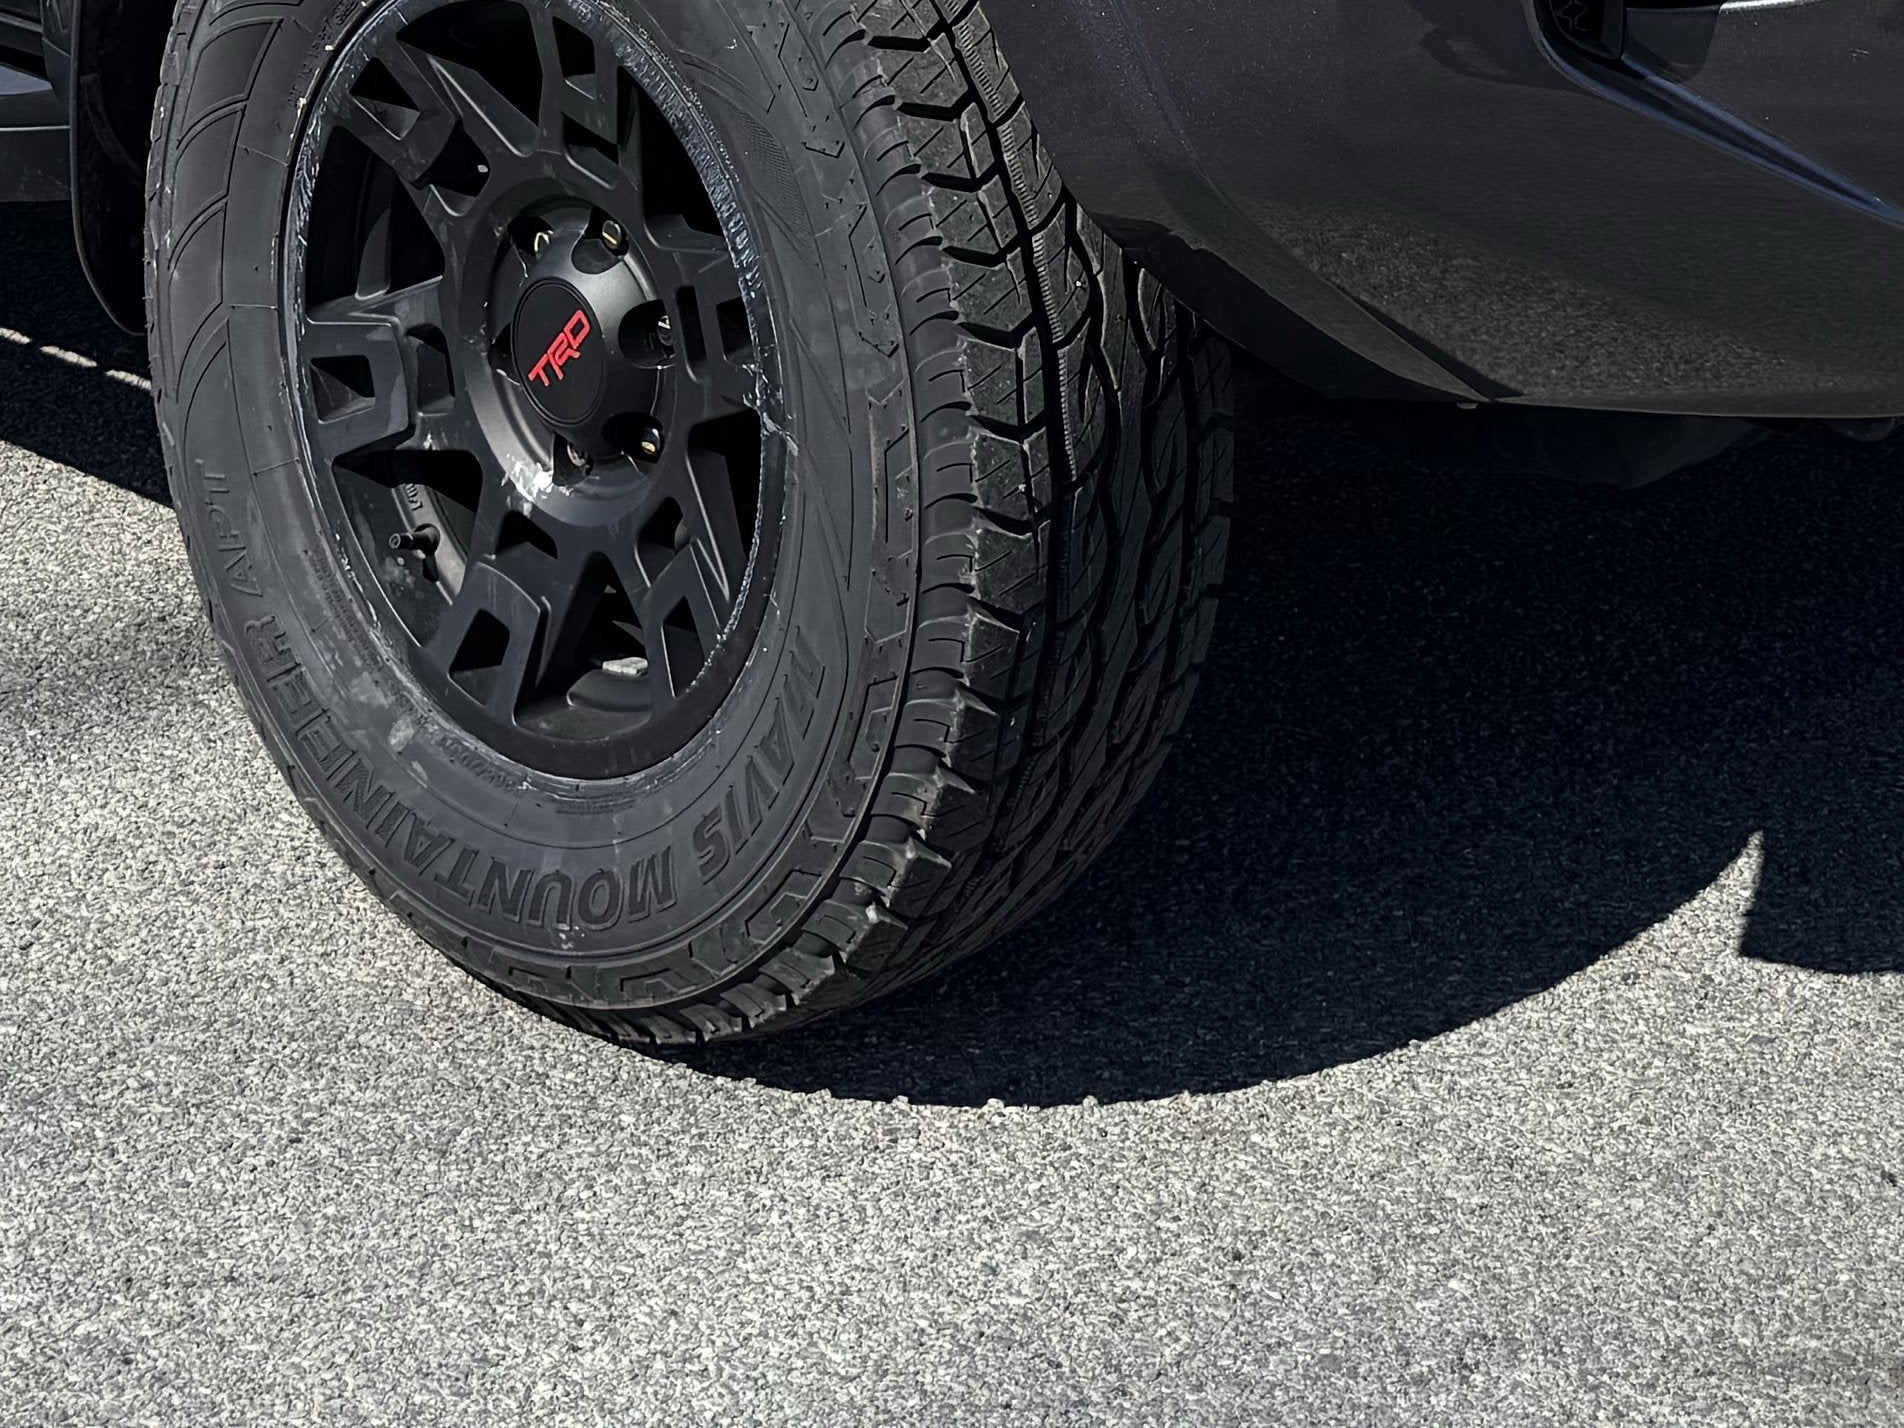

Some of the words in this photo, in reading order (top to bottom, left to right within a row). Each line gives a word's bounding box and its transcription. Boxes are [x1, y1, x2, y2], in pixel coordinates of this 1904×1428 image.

[528, 309, 591, 386] TRD
[196, 456, 266, 600] APT
[242, 612, 678, 932] MOUNTAINEER
